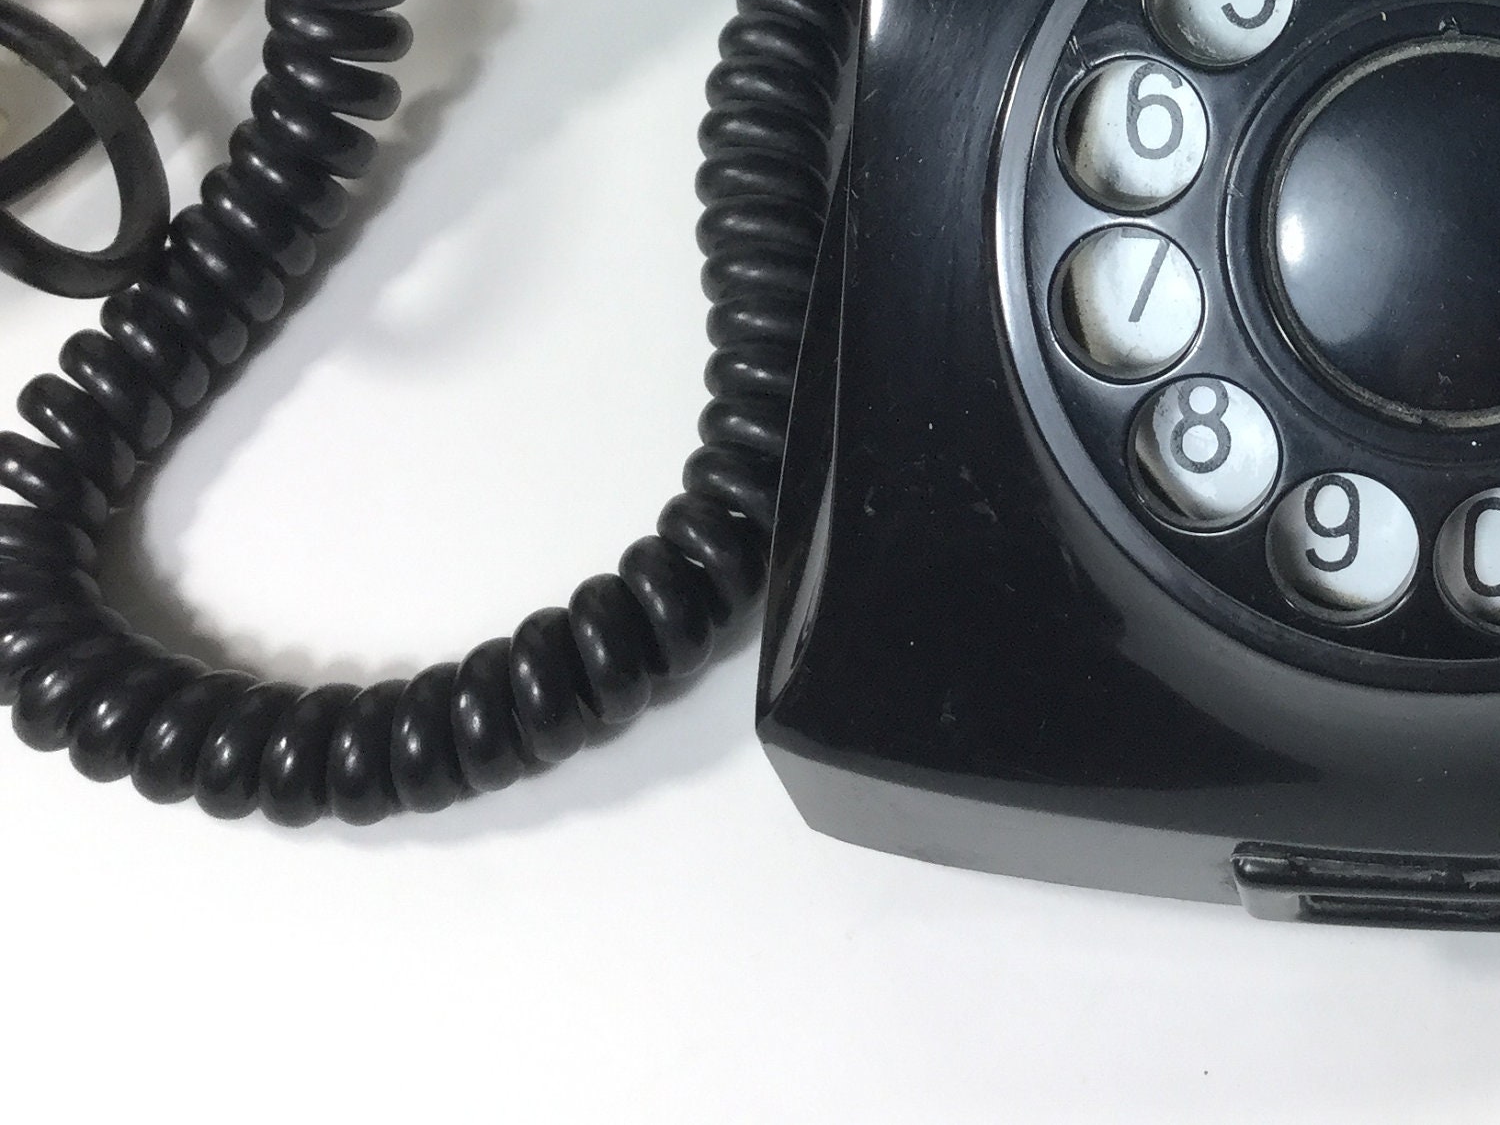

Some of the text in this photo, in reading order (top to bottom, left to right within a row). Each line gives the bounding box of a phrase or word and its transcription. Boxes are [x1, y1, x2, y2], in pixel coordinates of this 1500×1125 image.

[1125, 62, 1183, 160] 6
[1120, 227, 1168, 323] 7
[1170, 380, 1230, 474] 8
[1303, 475, 1361, 573] 9
